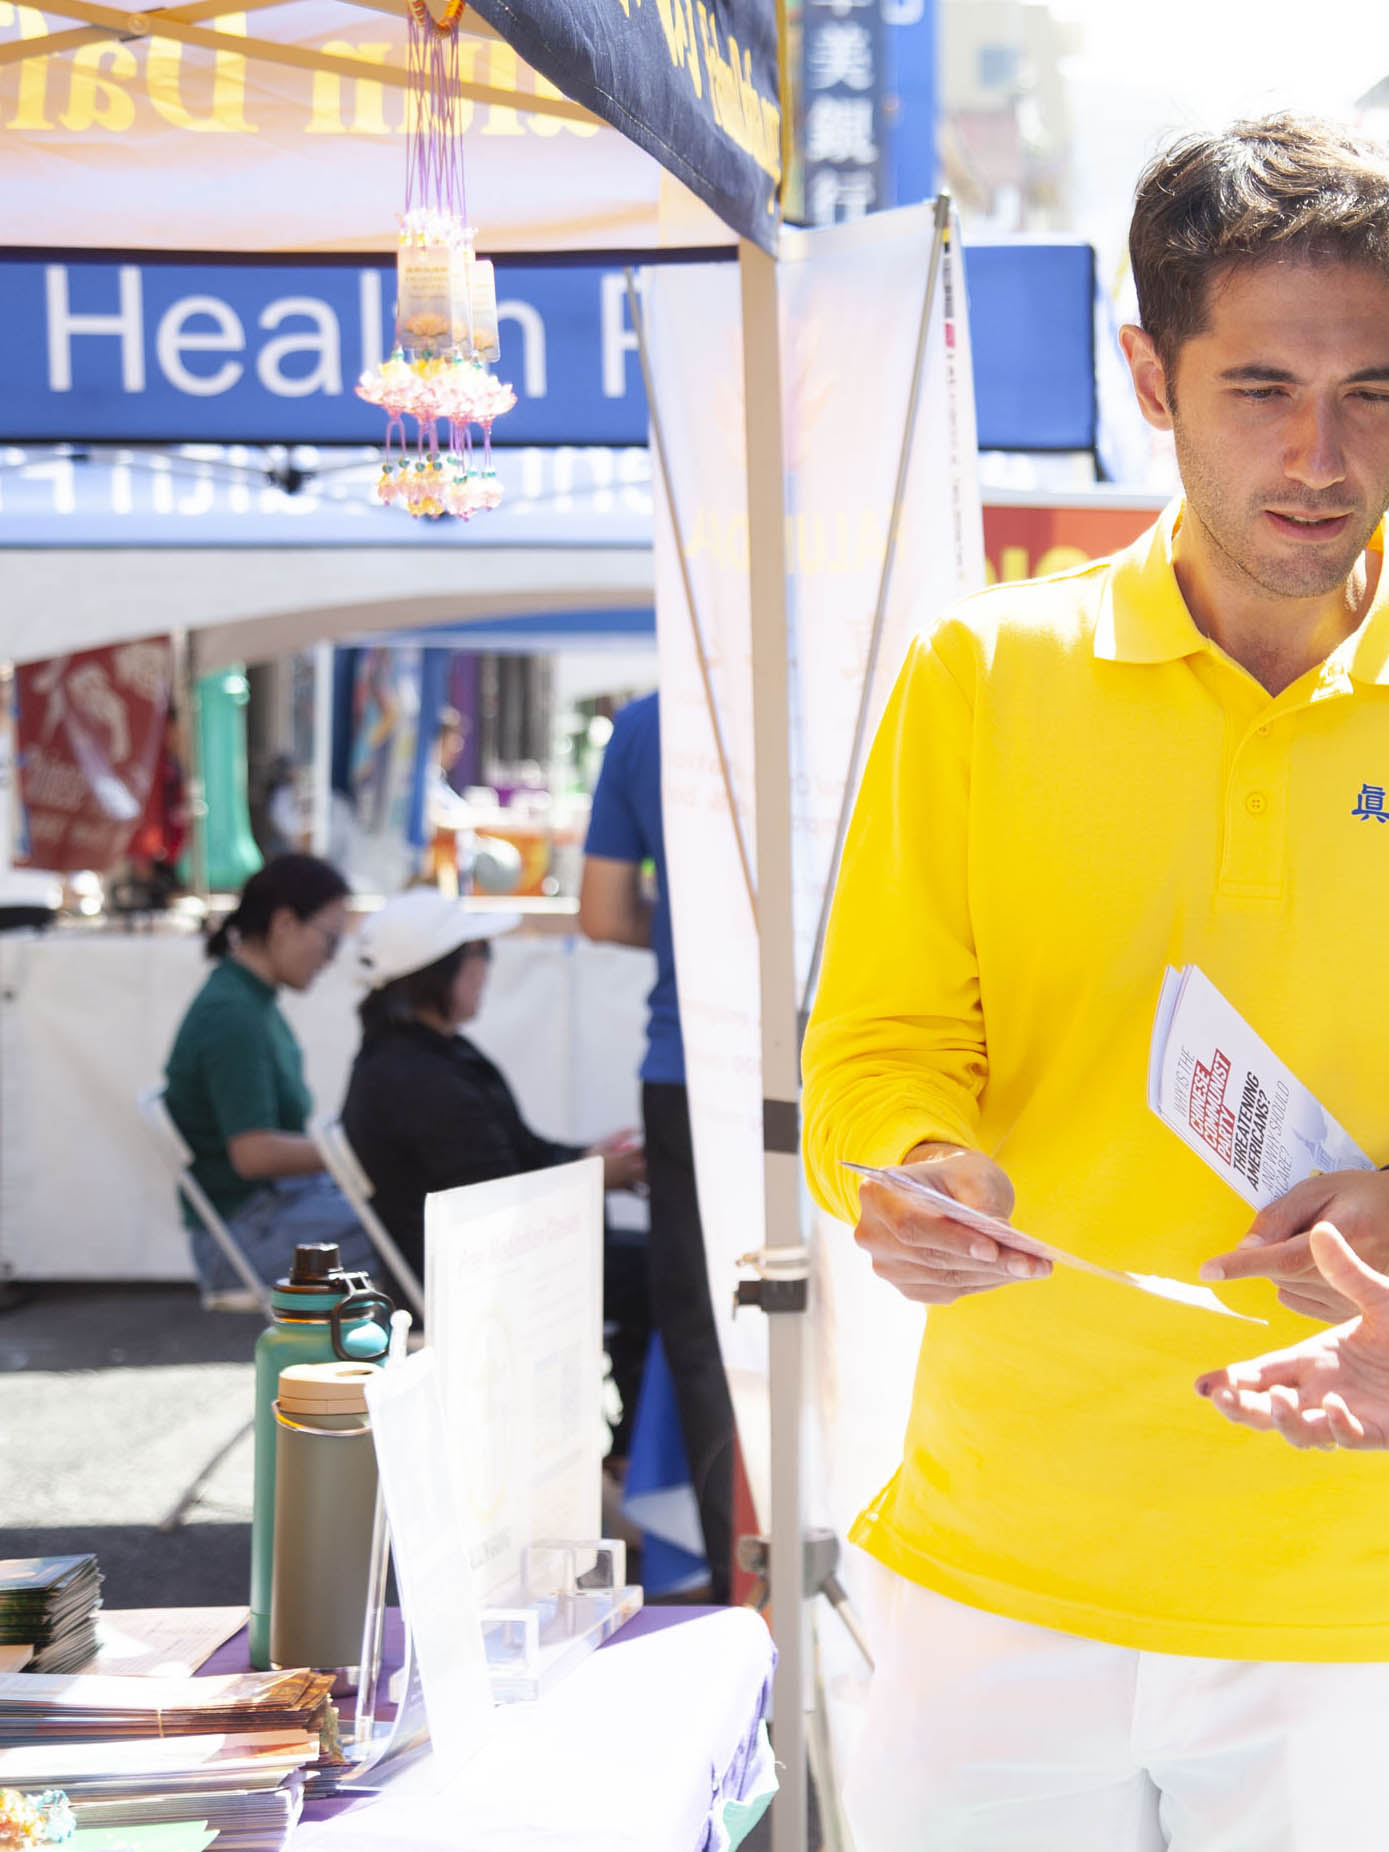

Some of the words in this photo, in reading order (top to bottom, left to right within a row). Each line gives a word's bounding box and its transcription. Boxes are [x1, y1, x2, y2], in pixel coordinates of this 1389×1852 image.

[1178, 1045, 1196, 1074] THE
[1191, 1066, 1210, 1134] CHINESE
[1204, 1053, 1231, 1147] COMMUNIST
[1232, 1070, 1261, 1175] THREATENING
[1270, 1080, 1290, 1136] SHOULD
[1216, 1107, 1235, 1161] PARTY
[1246, 1089, 1272, 1192] AMERICANS?
[1264, 1131, 1279, 1166] WHY
[1261, 1162, 1274, 1192] AND
[1275, 1145, 1294, 1192] CARE?
